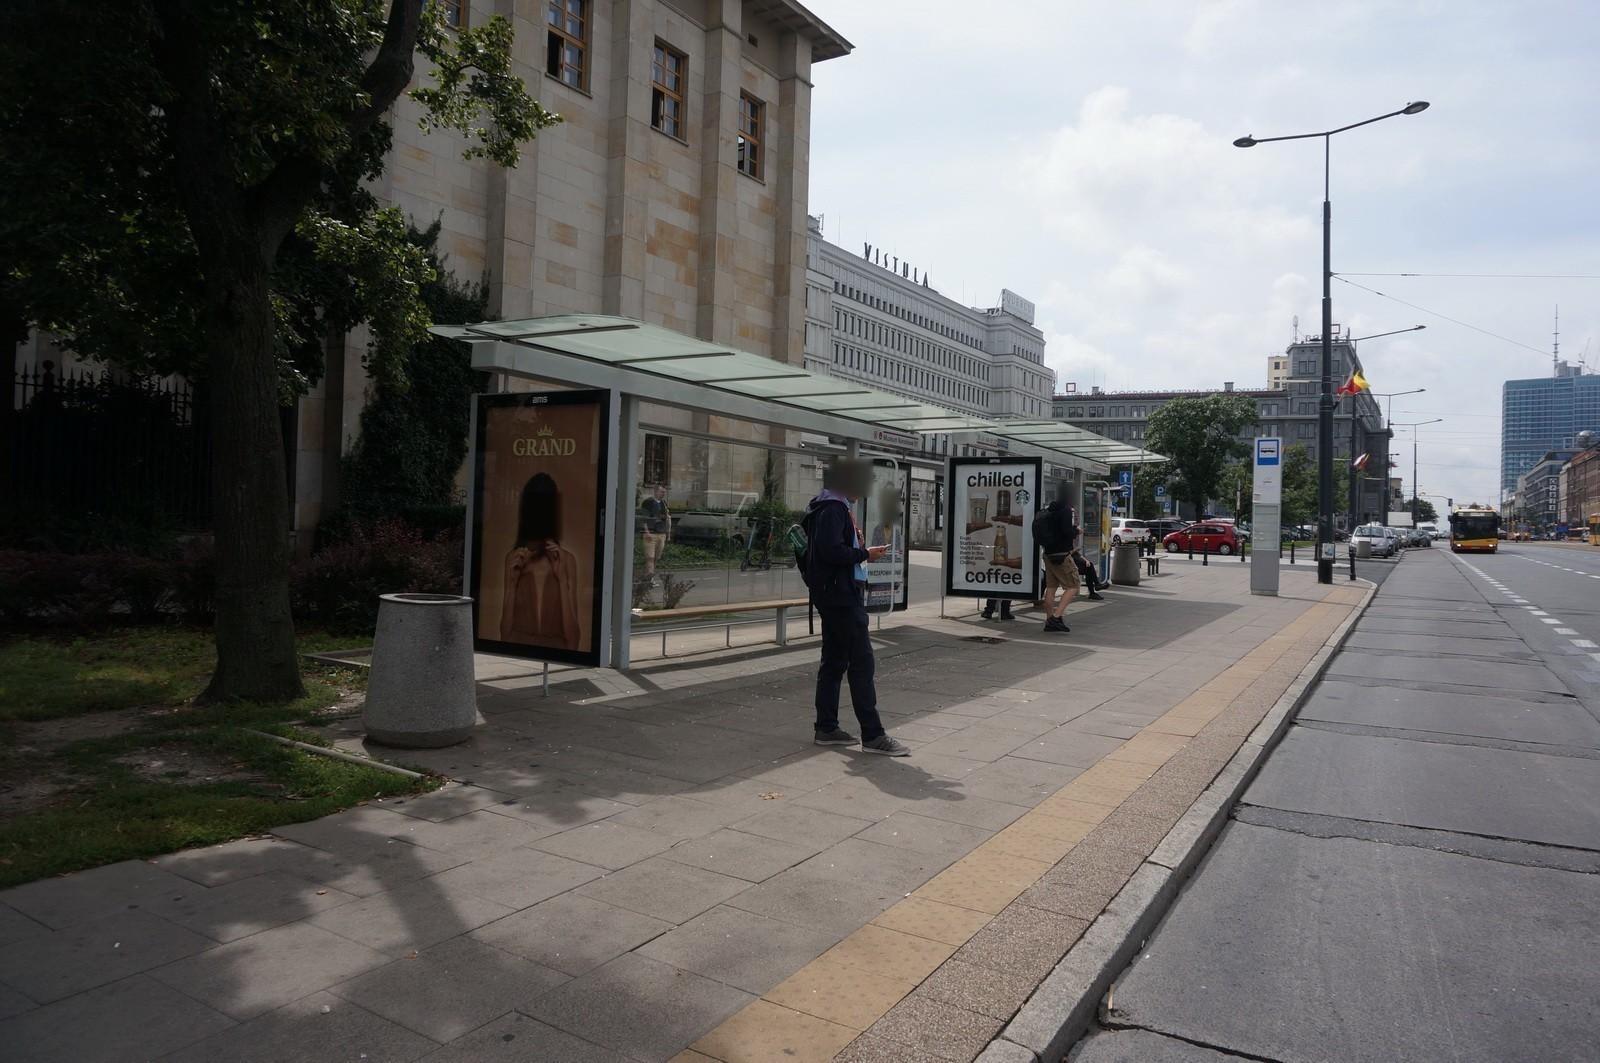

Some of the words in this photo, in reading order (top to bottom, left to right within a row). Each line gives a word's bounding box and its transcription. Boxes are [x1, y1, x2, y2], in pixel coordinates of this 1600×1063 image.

[864, 242, 928, 288] VISTULA
[513, 438, 576, 456] GRAND
[967, 472, 1024, 487] chilled
[1157, 486, 1164, 496] P
[965, 568, 1022, 584] coffee
